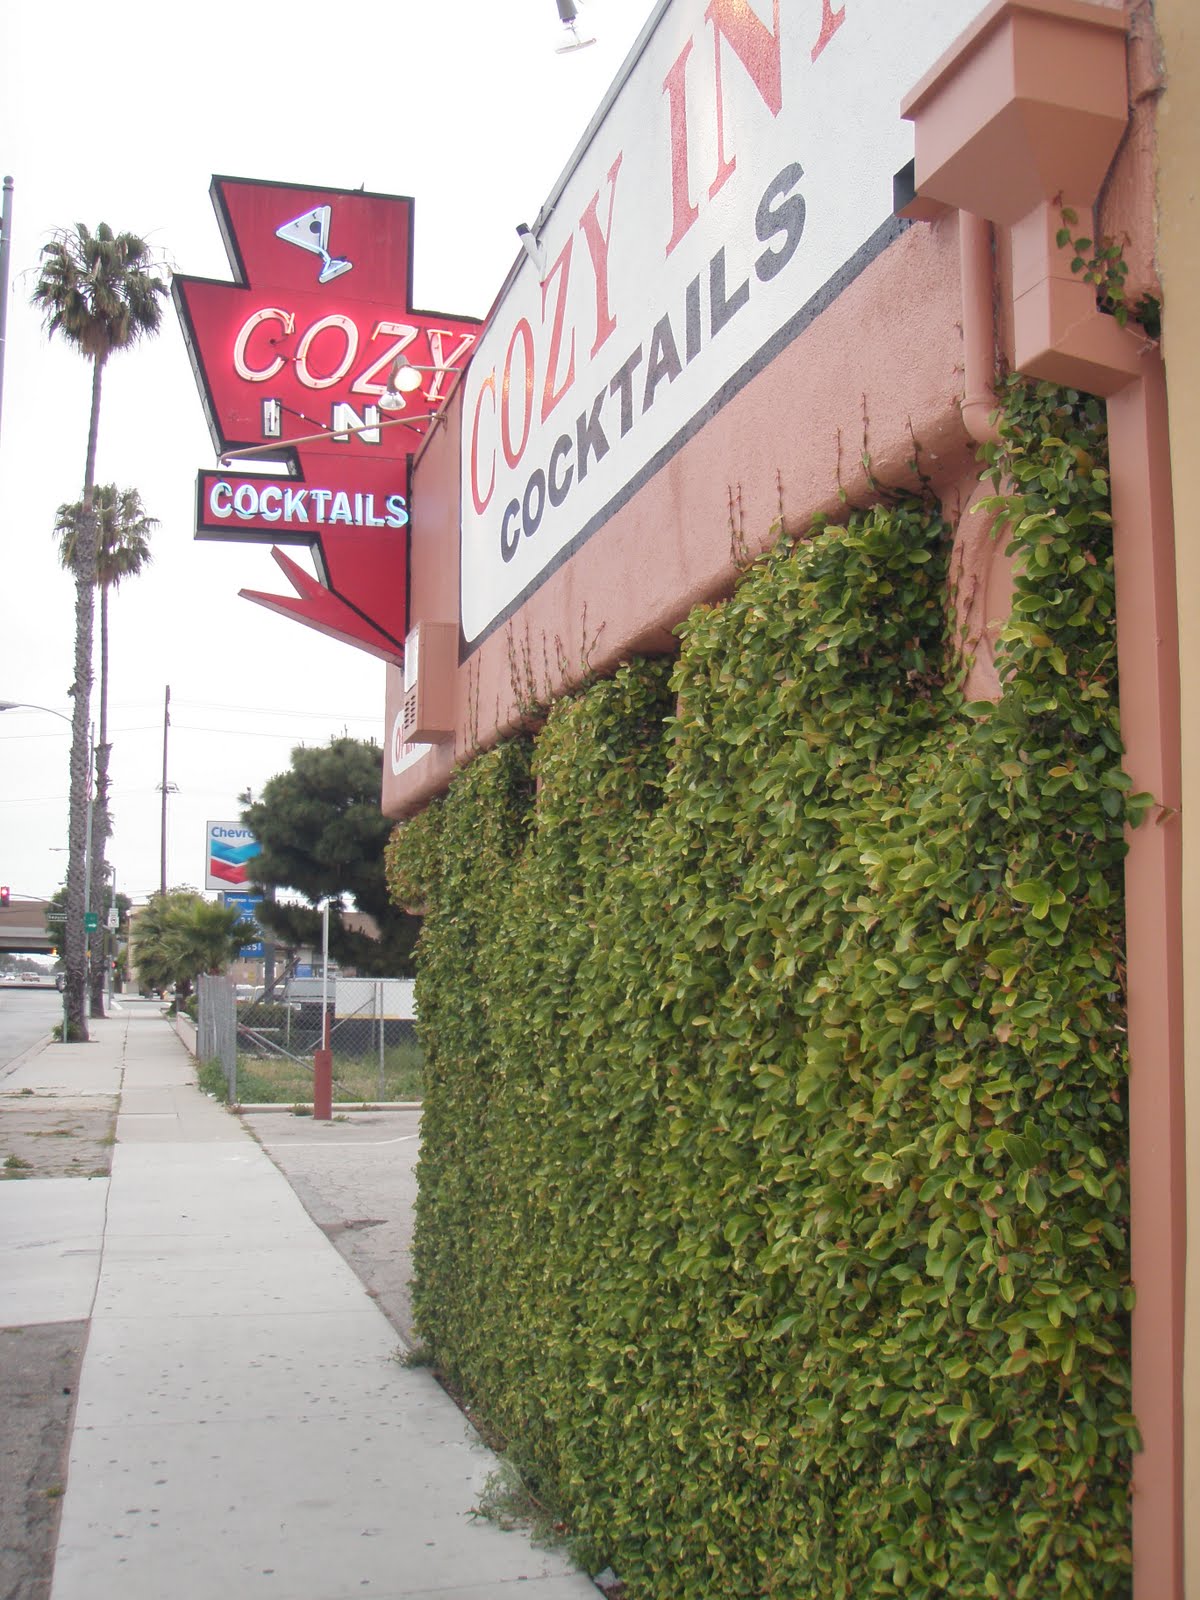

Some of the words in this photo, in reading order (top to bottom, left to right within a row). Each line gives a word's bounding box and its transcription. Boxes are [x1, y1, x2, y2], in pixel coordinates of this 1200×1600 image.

[471, 149, 623, 515] COZY
[661, 0, 846, 260] IN
[233, 307, 476, 402] COZY
[500, 161, 806, 563] COCKTAILS
[210, 481, 409, 529] COCKTAILS
[211, 826, 255, 839] Chevro
